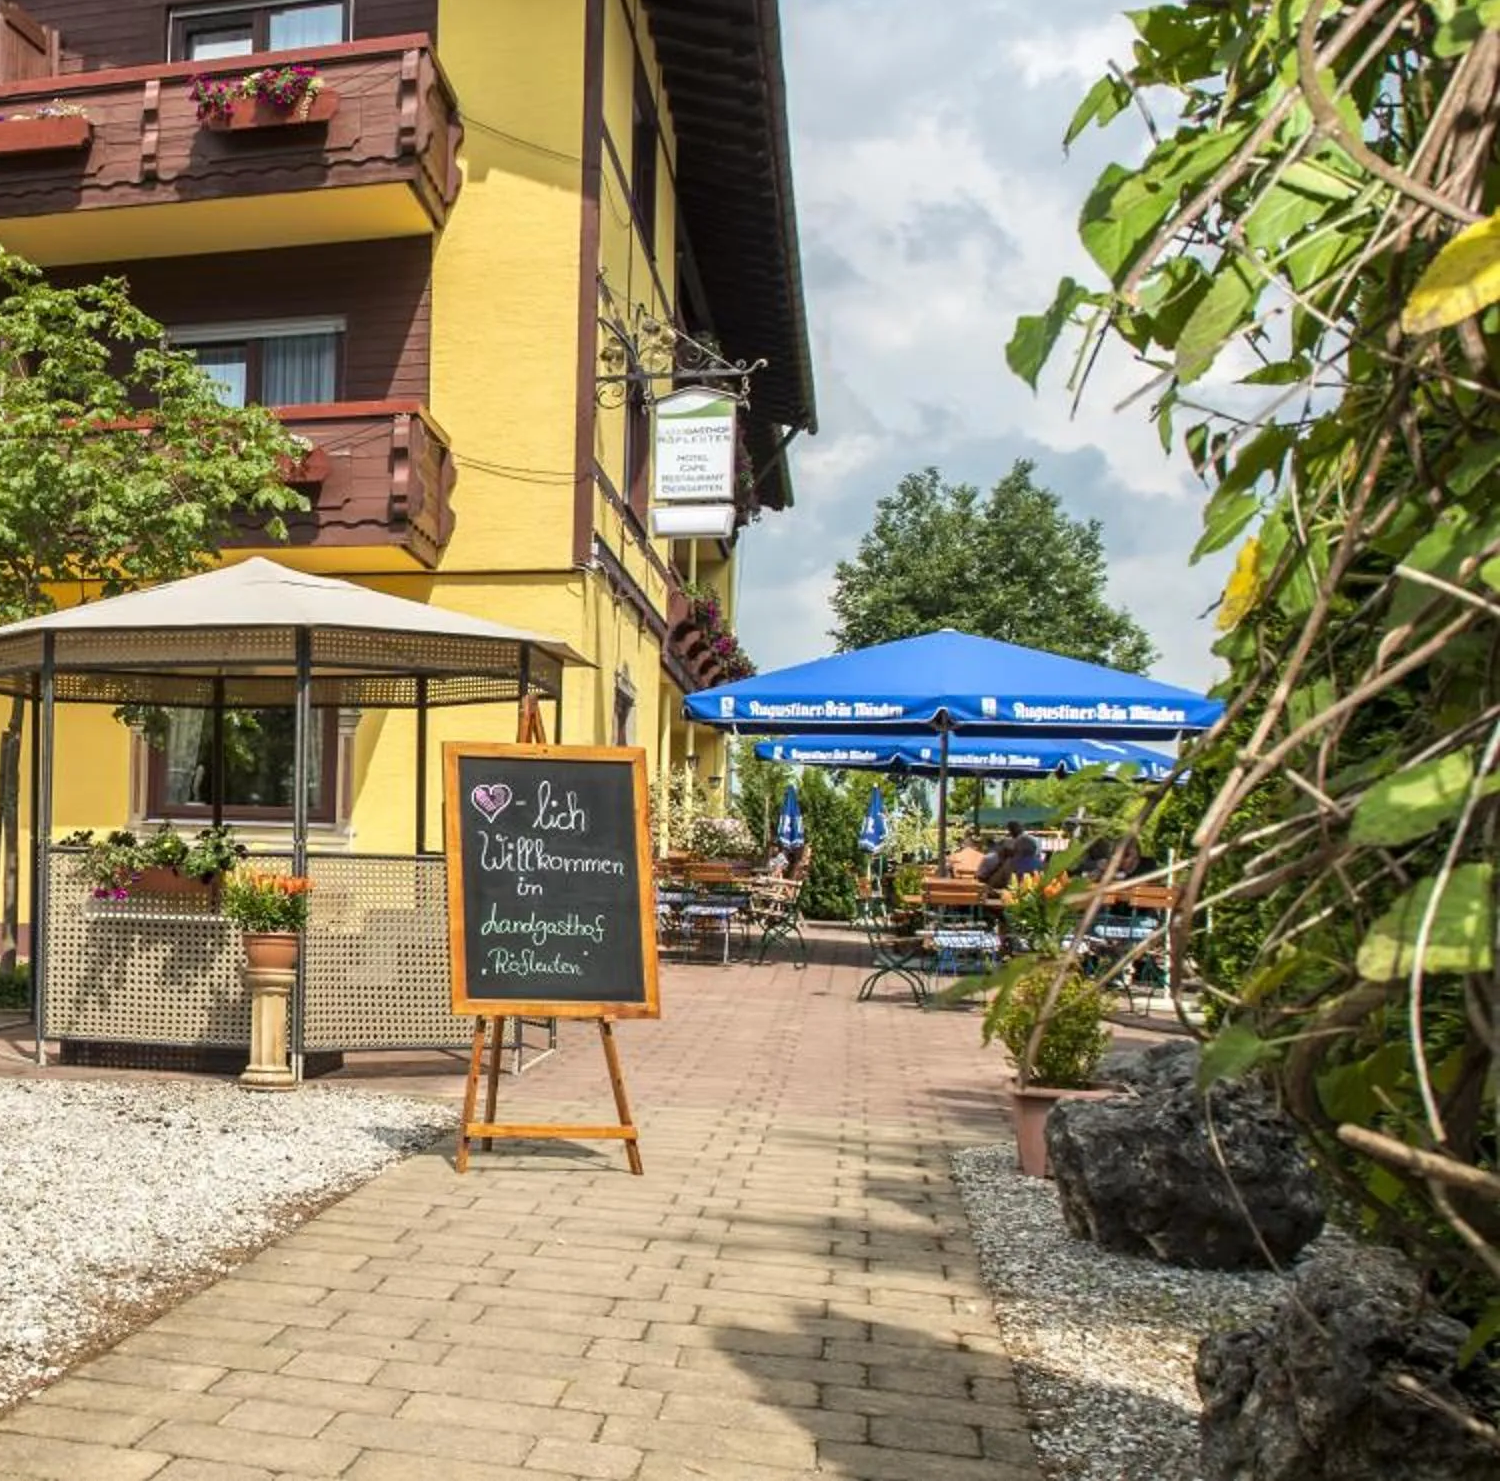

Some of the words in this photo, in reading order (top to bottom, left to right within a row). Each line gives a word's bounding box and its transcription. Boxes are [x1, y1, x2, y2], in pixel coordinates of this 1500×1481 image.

[659, 425, 730, 435] GASTHOF
[477, 830, 625, 876] Willkommen
[480, 902, 606, 945] Landgasthof
